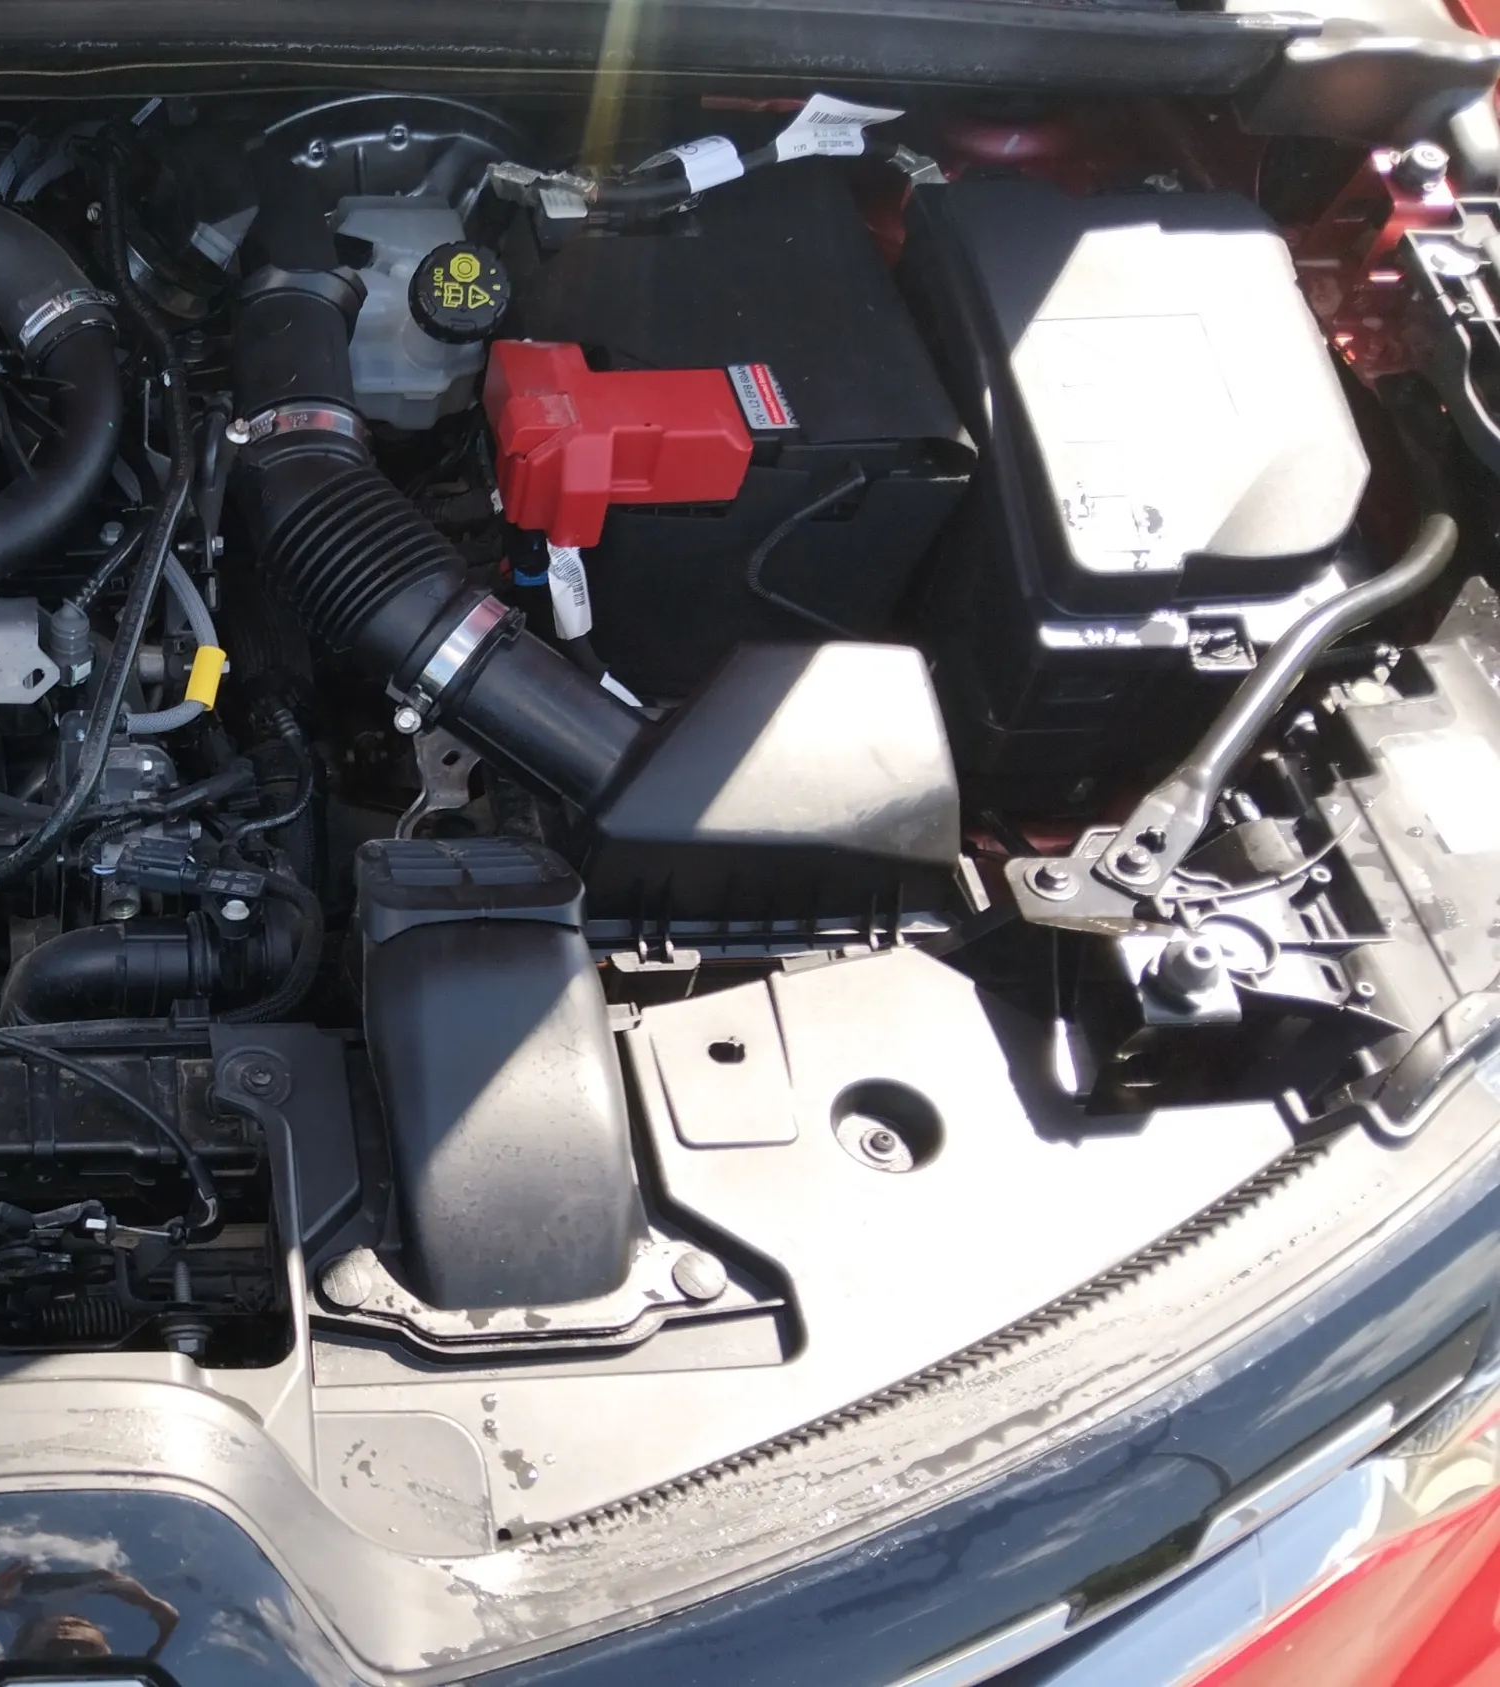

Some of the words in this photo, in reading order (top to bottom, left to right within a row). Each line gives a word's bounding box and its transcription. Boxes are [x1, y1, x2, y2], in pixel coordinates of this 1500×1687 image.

[433, 268, 444, 288] DOT
[433, 290, 442, 298] 4
[743, 384, 757, 398] EFB
[754, 412, 767, 425] 12V
